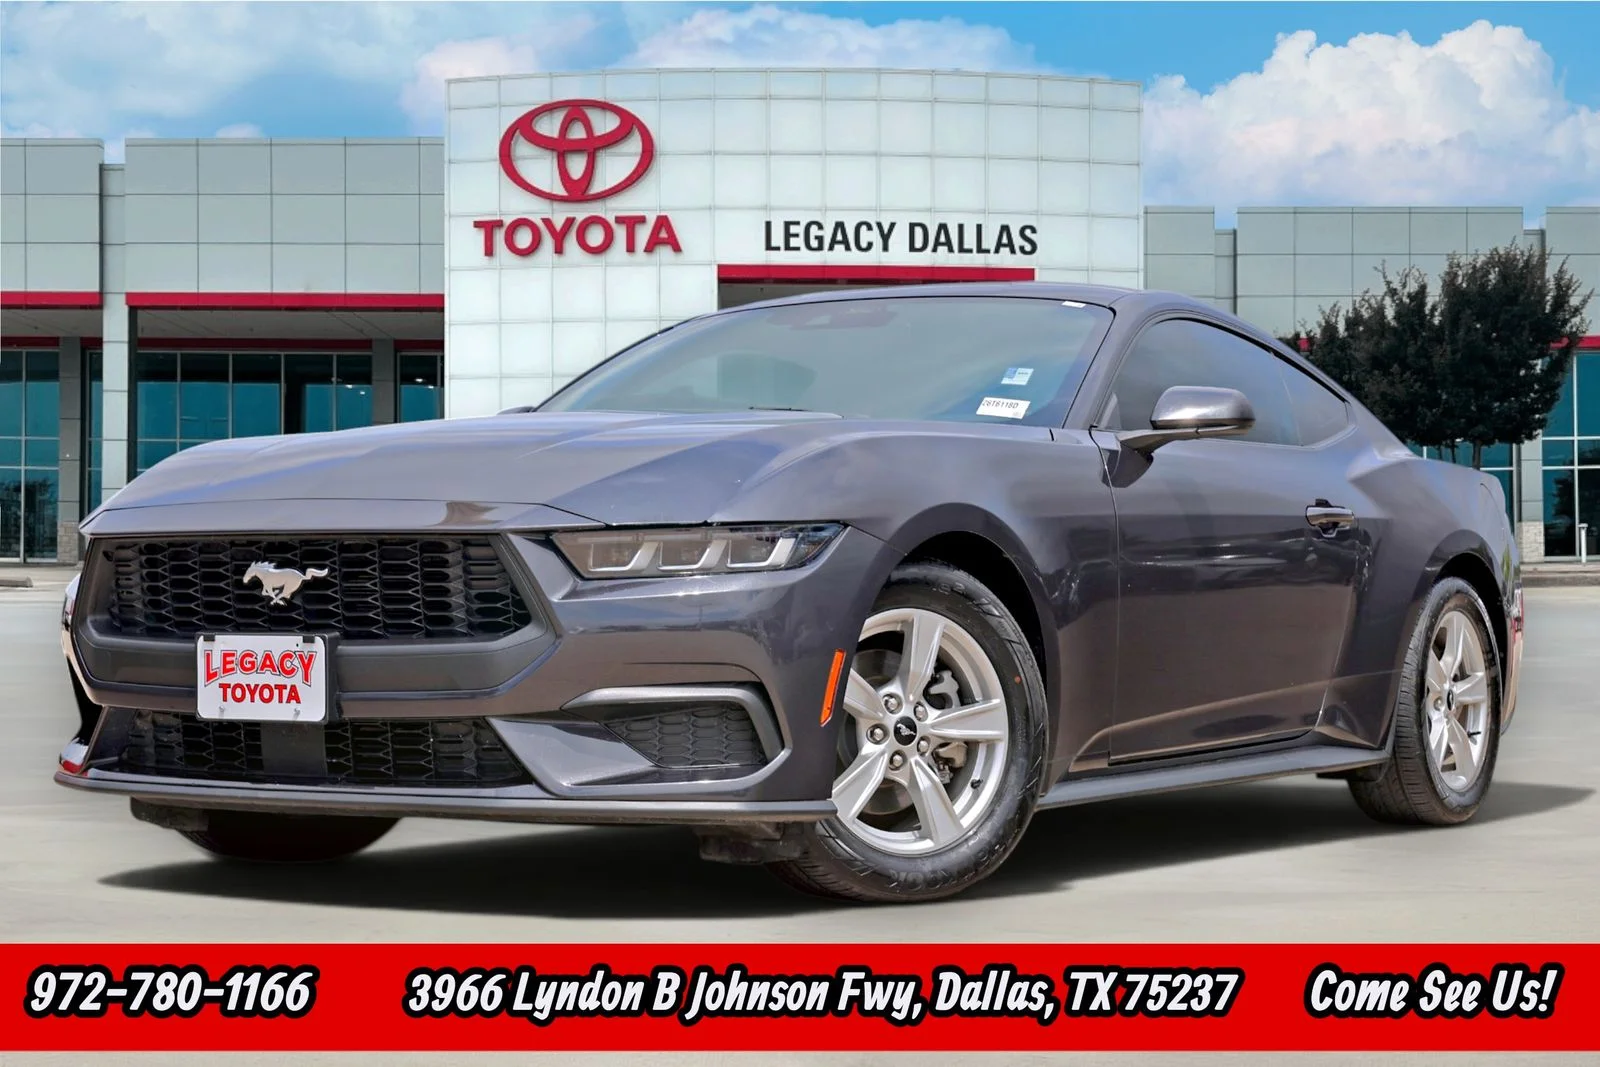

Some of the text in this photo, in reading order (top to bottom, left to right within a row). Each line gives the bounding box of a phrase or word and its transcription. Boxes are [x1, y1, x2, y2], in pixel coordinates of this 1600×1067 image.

[474, 214, 682, 257] TOYOTA
[764, 220, 1038, 257] LEGACY DALLAS
[204, 649, 317, 687] LEGACY
[218, 683, 302, 705] TOYOTA
